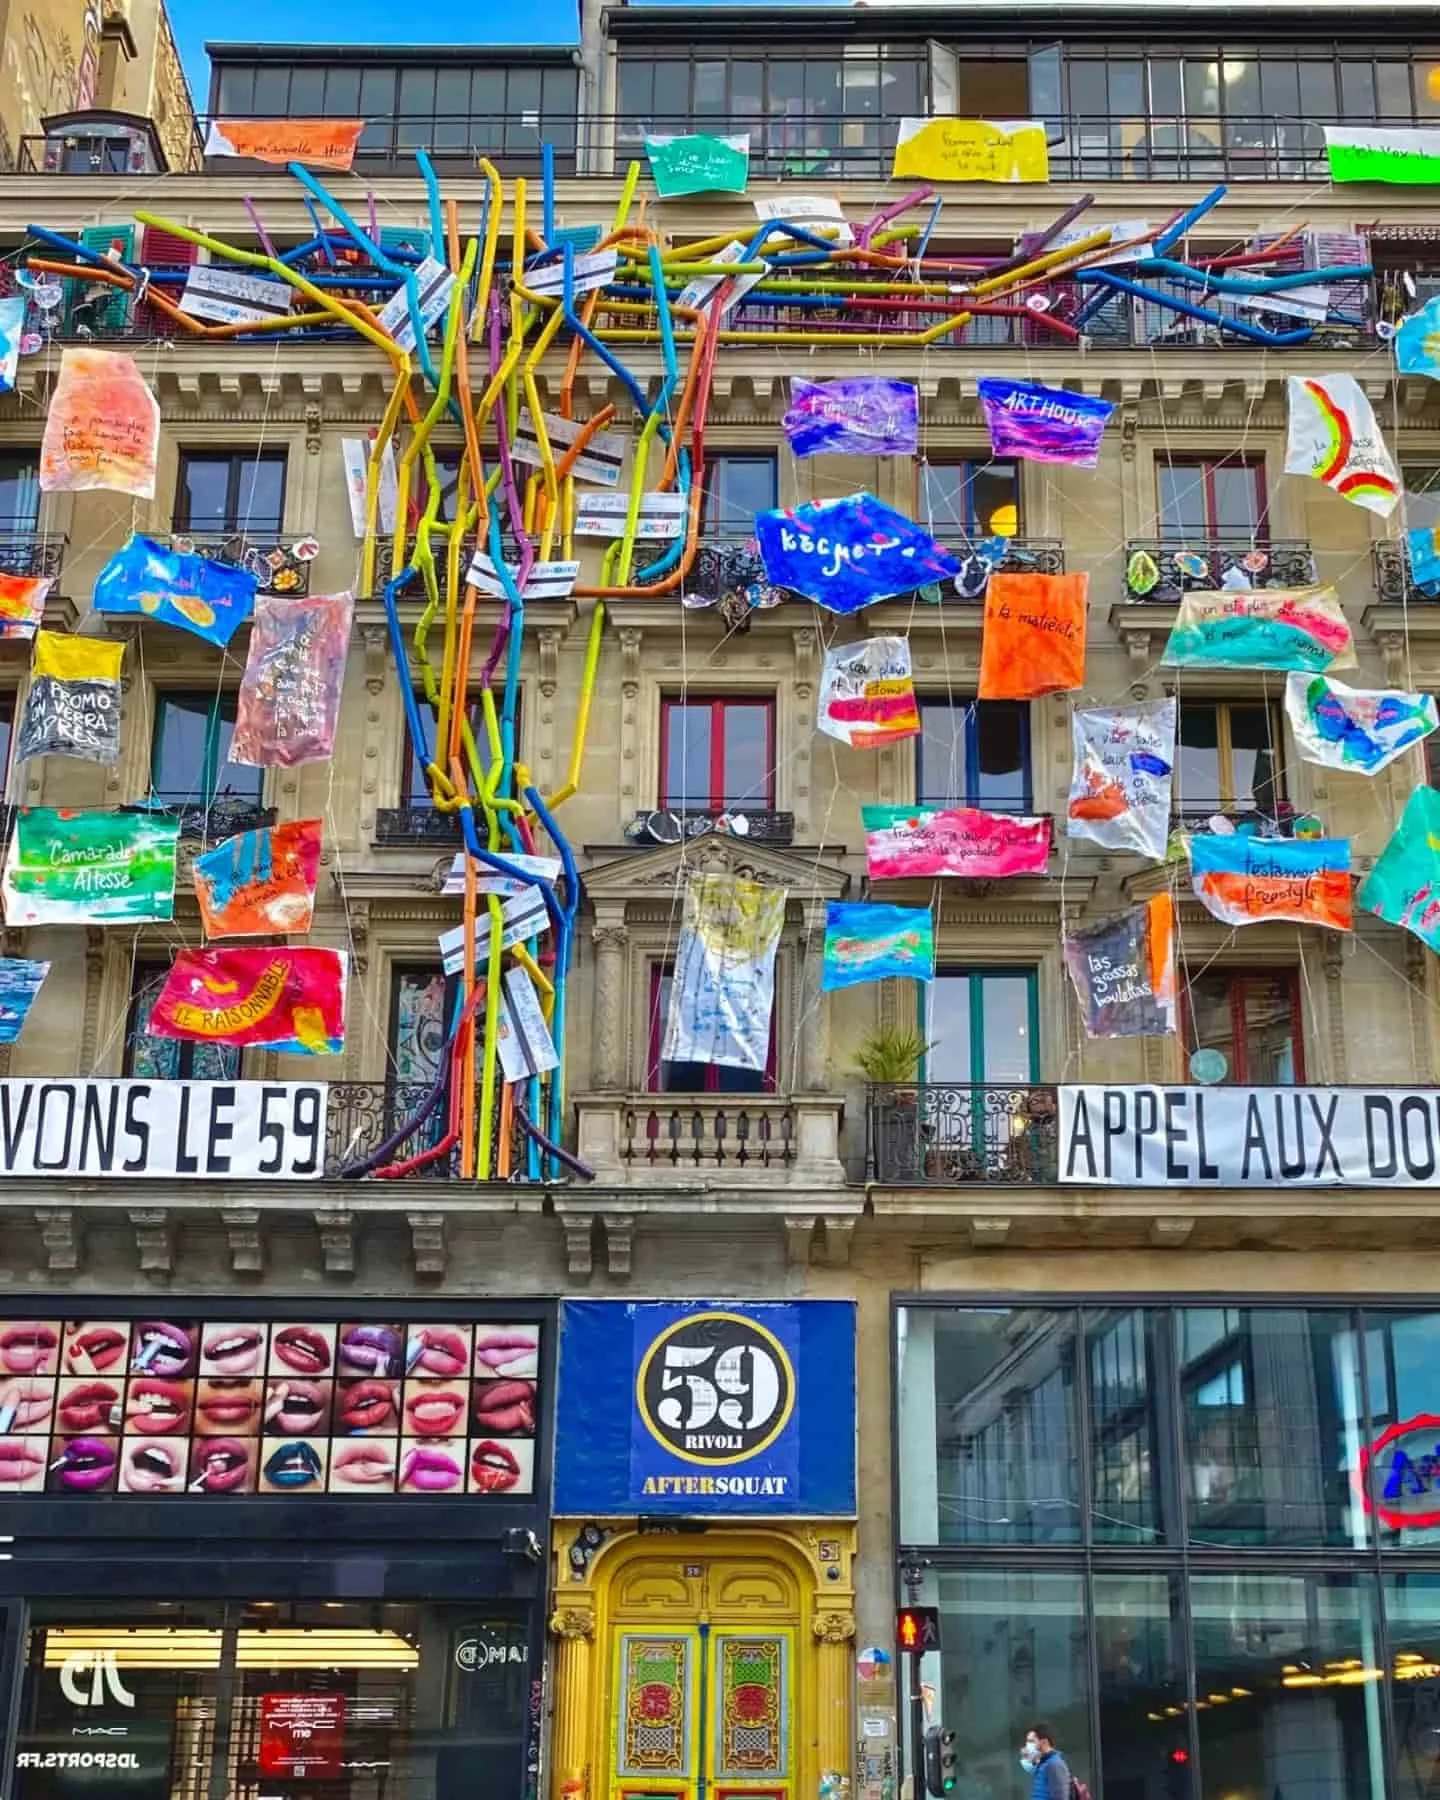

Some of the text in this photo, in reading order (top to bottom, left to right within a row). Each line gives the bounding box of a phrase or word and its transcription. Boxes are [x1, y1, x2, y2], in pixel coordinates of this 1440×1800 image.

[1002, 391, 1041, 413] ART
[51, 681, 111, 711] PROMO
[54, 700, 108, 733] VERRA
[73, 868, 134, 892] Altesse
[174, 957, 289, 1031] LE RAISONNABLE
[0, 1084, 321, 1174] VONS LE 59
[1066, 1089, 1440, 1182] APPEL AUX DO
[657, 1344, 779, 1430] 59
[685, 1433, 744, 1450] RIVOLI
[641, 1475, 788, 1496] AFTERSQUAT
[71, 1727, 129, 1737] MAC
[269, 1719, 337, 1730] MAC
